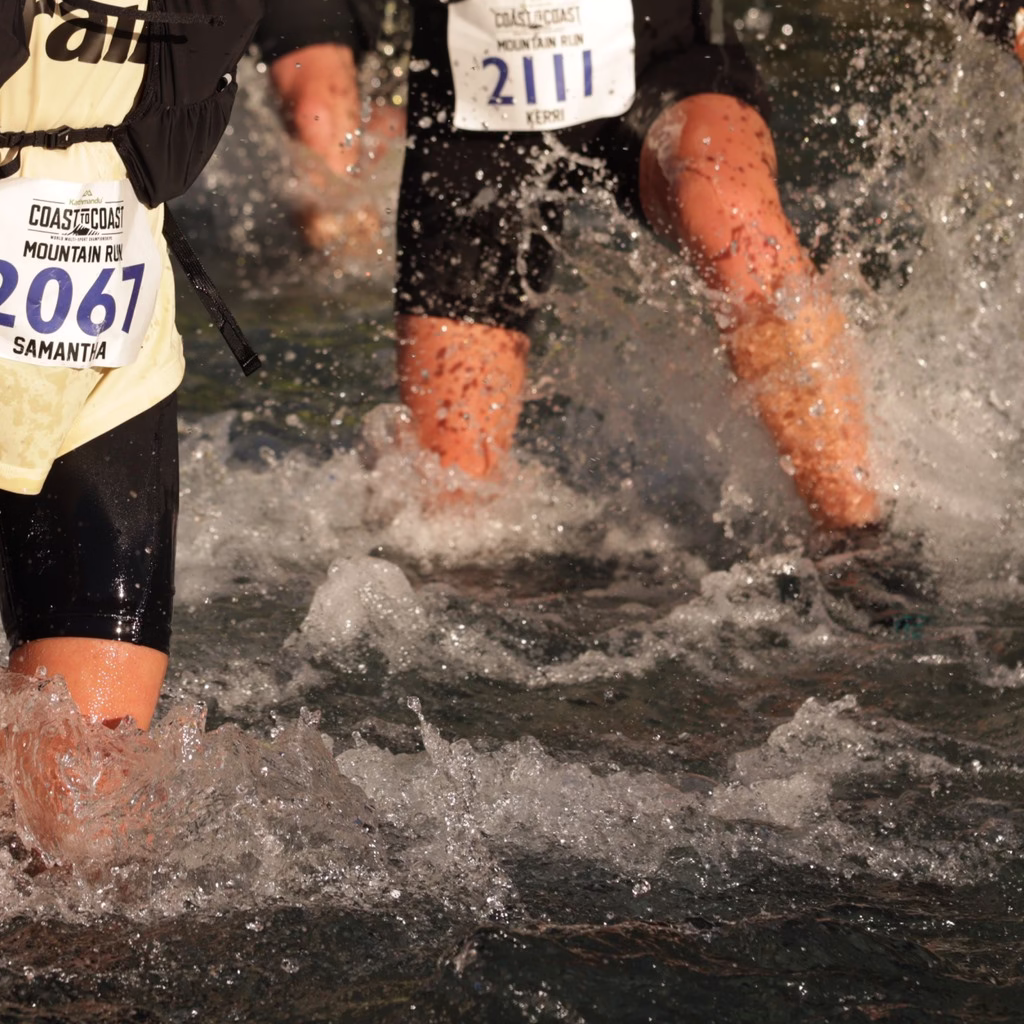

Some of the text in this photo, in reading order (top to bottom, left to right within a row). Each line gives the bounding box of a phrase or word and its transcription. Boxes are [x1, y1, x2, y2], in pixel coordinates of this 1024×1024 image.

[497, 33, 584, 52] MOUNTAIN RUN
[482, 50, 593, 105] 2111
[526, 109, 565, 126] KERRI
[28, 204, 124, 231] COAST TO COAST
[23, 240, 124, 263] MOUNTAIN RUN
[12, 336, 107, 363] SAMANTHA
